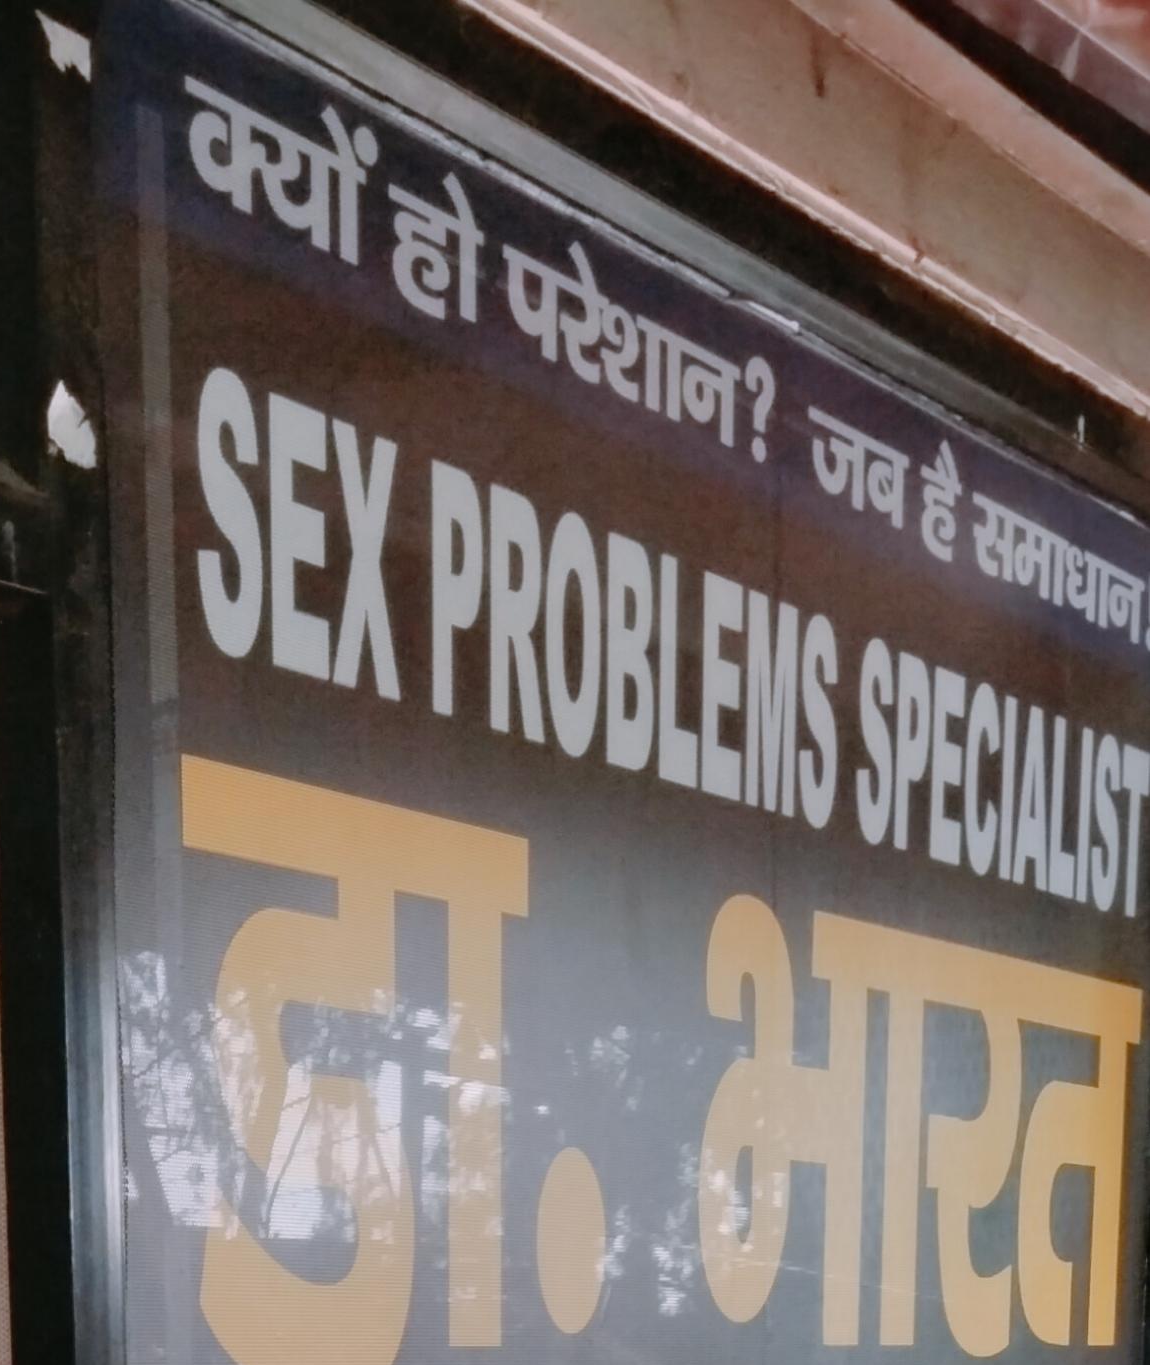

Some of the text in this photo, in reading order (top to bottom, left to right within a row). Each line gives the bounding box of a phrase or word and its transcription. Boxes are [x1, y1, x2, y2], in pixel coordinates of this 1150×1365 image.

[185, 75, 1150, 652] क्यों हो परेशान? जब है समाधान
[197, 366, 1150, 918] SEX PROBLEMS SPECIALIST
[698, 893, 1144, 1358] भारत
